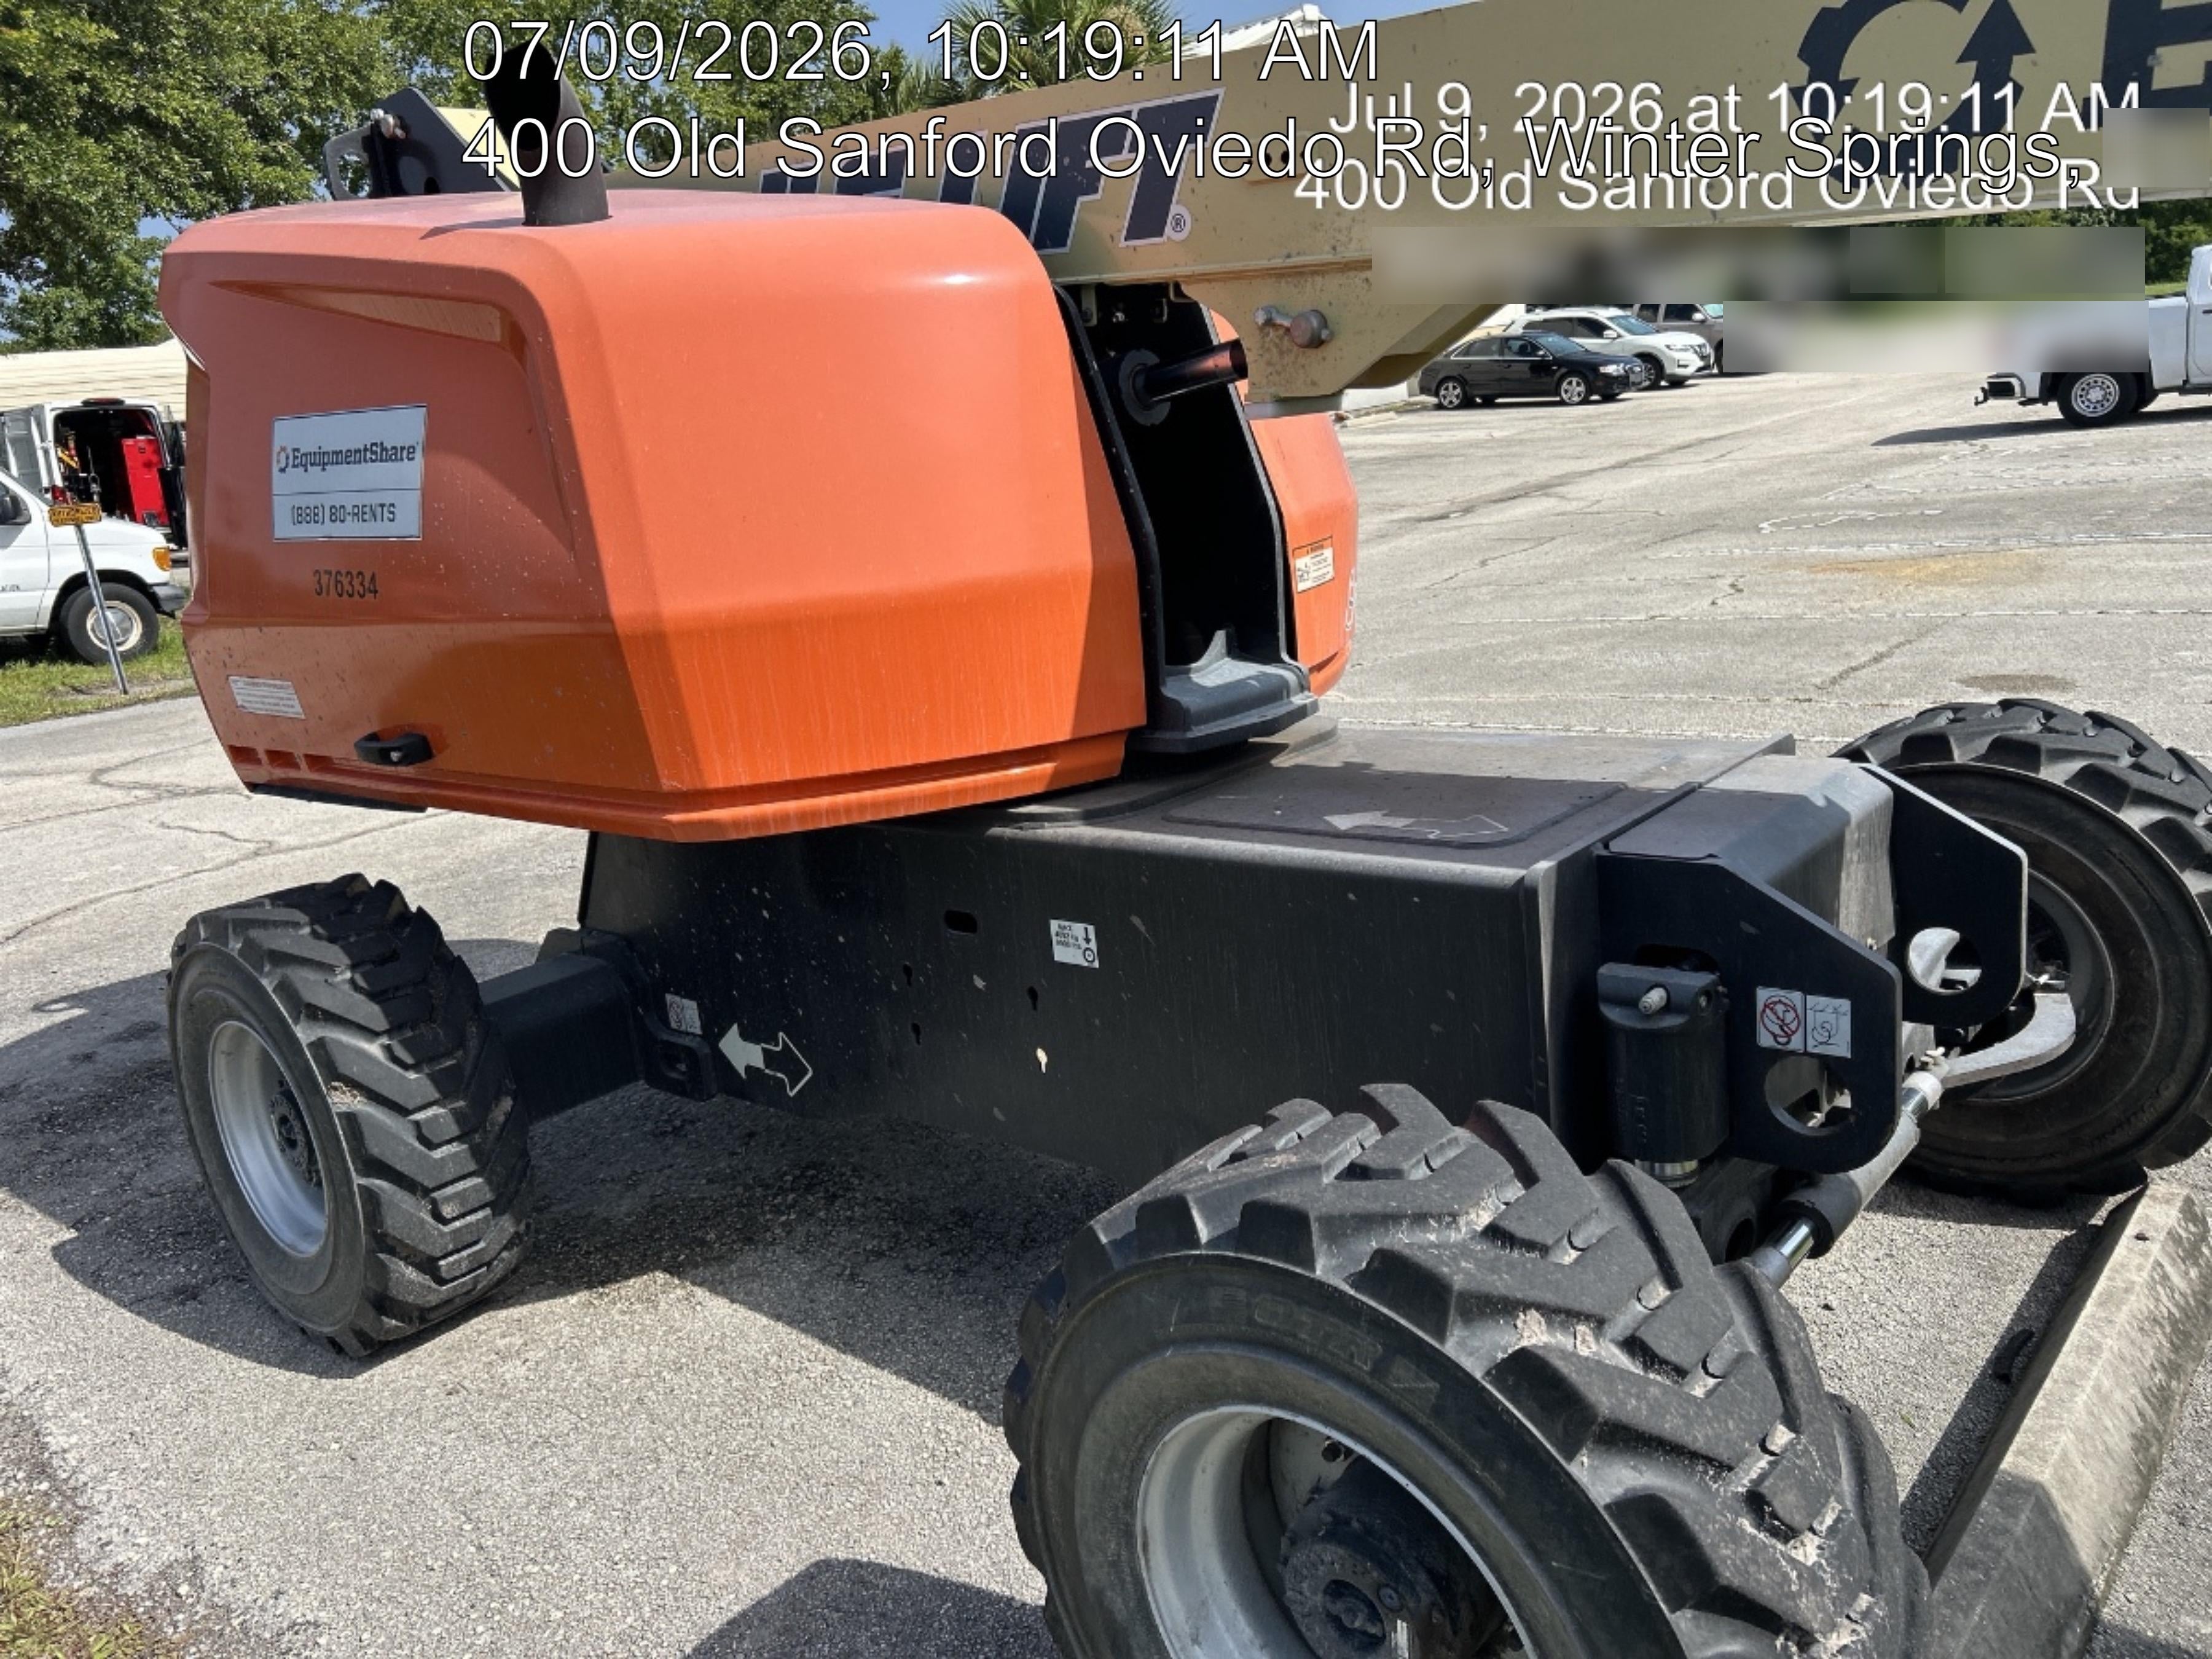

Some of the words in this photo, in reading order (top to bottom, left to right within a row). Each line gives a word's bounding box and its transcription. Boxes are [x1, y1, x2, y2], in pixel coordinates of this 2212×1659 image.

[291, 441, 416, 473] EquipmentShare
[291, 504, 325, 525] (888)
[329, 503, 396, 524] 80-RENTS
[313, 569, 379, 600] 376334
